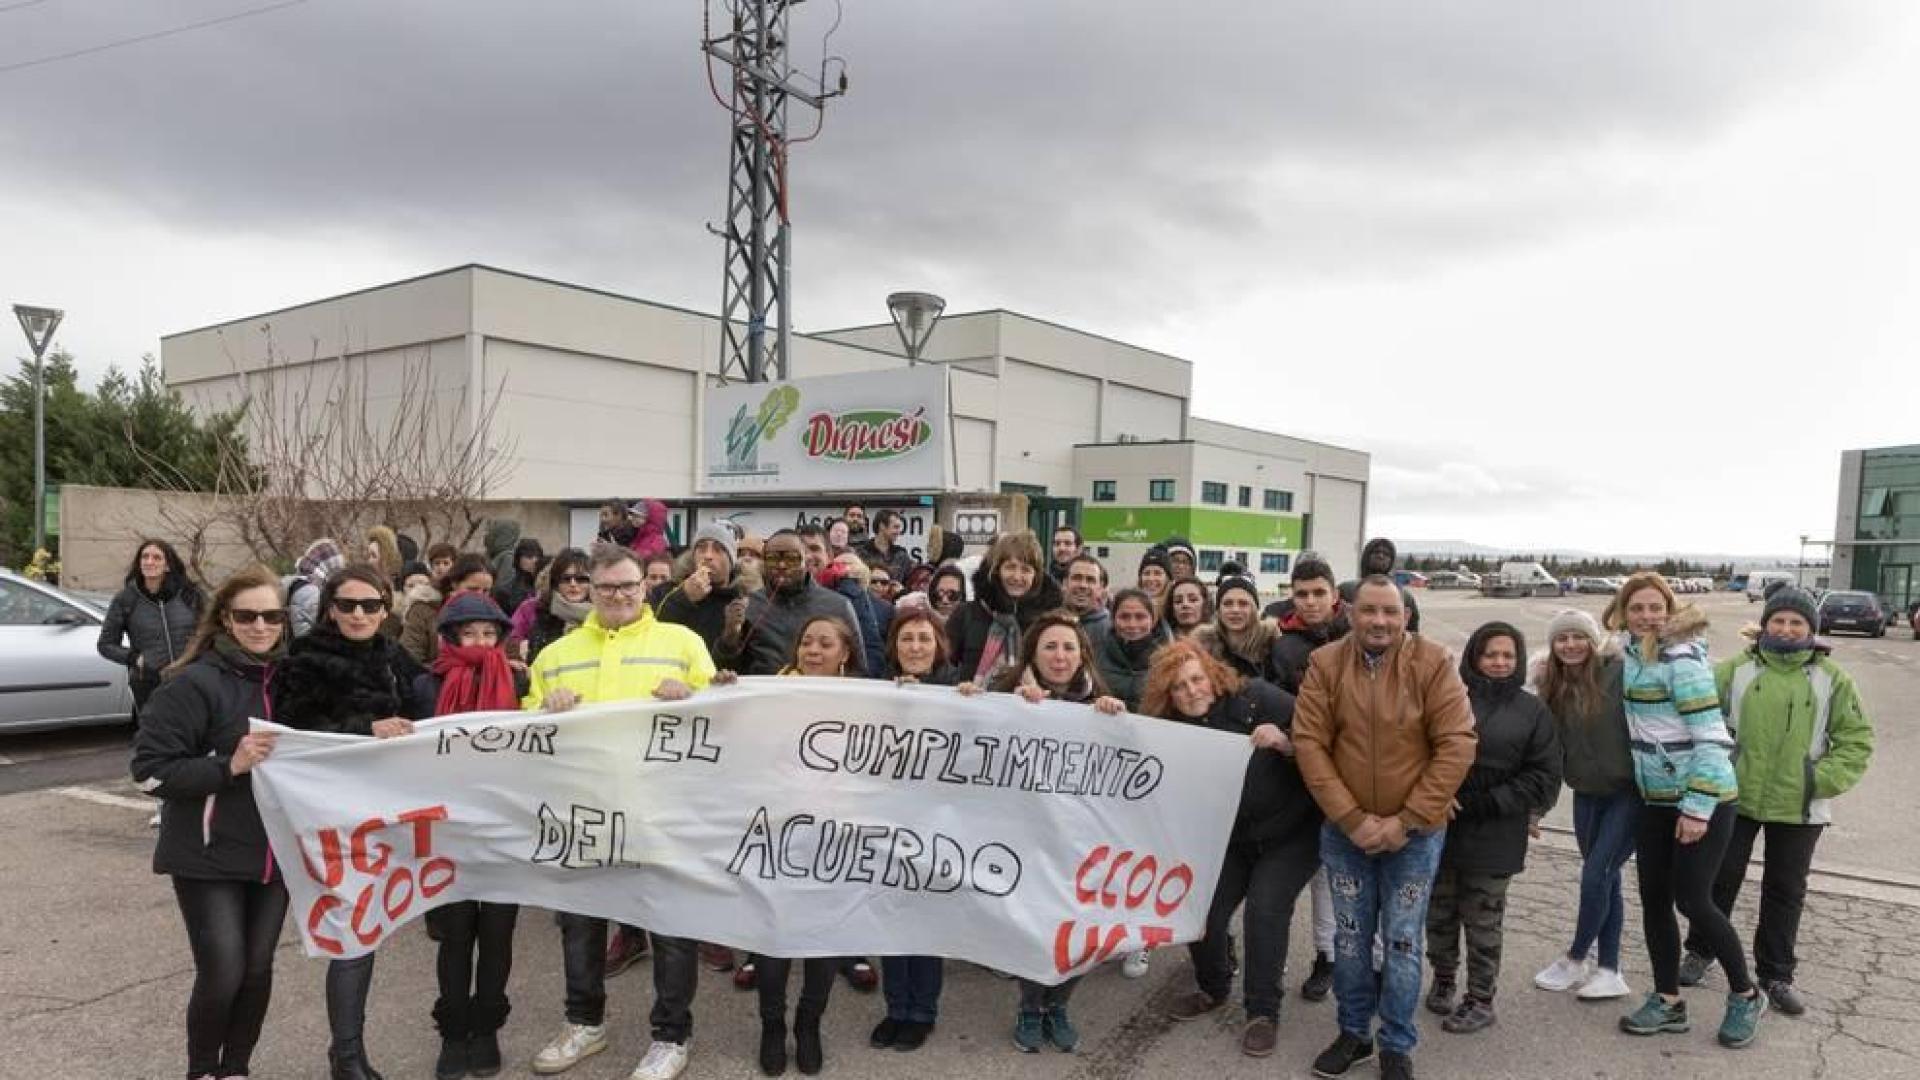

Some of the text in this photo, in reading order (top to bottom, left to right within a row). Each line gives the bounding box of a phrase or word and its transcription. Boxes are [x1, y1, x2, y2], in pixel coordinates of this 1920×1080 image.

[808, 406, 925, 461] Diquesí
[644, 714, 721, 762] EL
[800, 721, 1164, 799] CUMPLIMIENTO
[294, 804, 449, 888] UGT
[531, 802, 1022, 897] DEL ACUERDO
[1076, 845, 1193, 917] CCOO
[308, 857, 457, 955] CCOO
